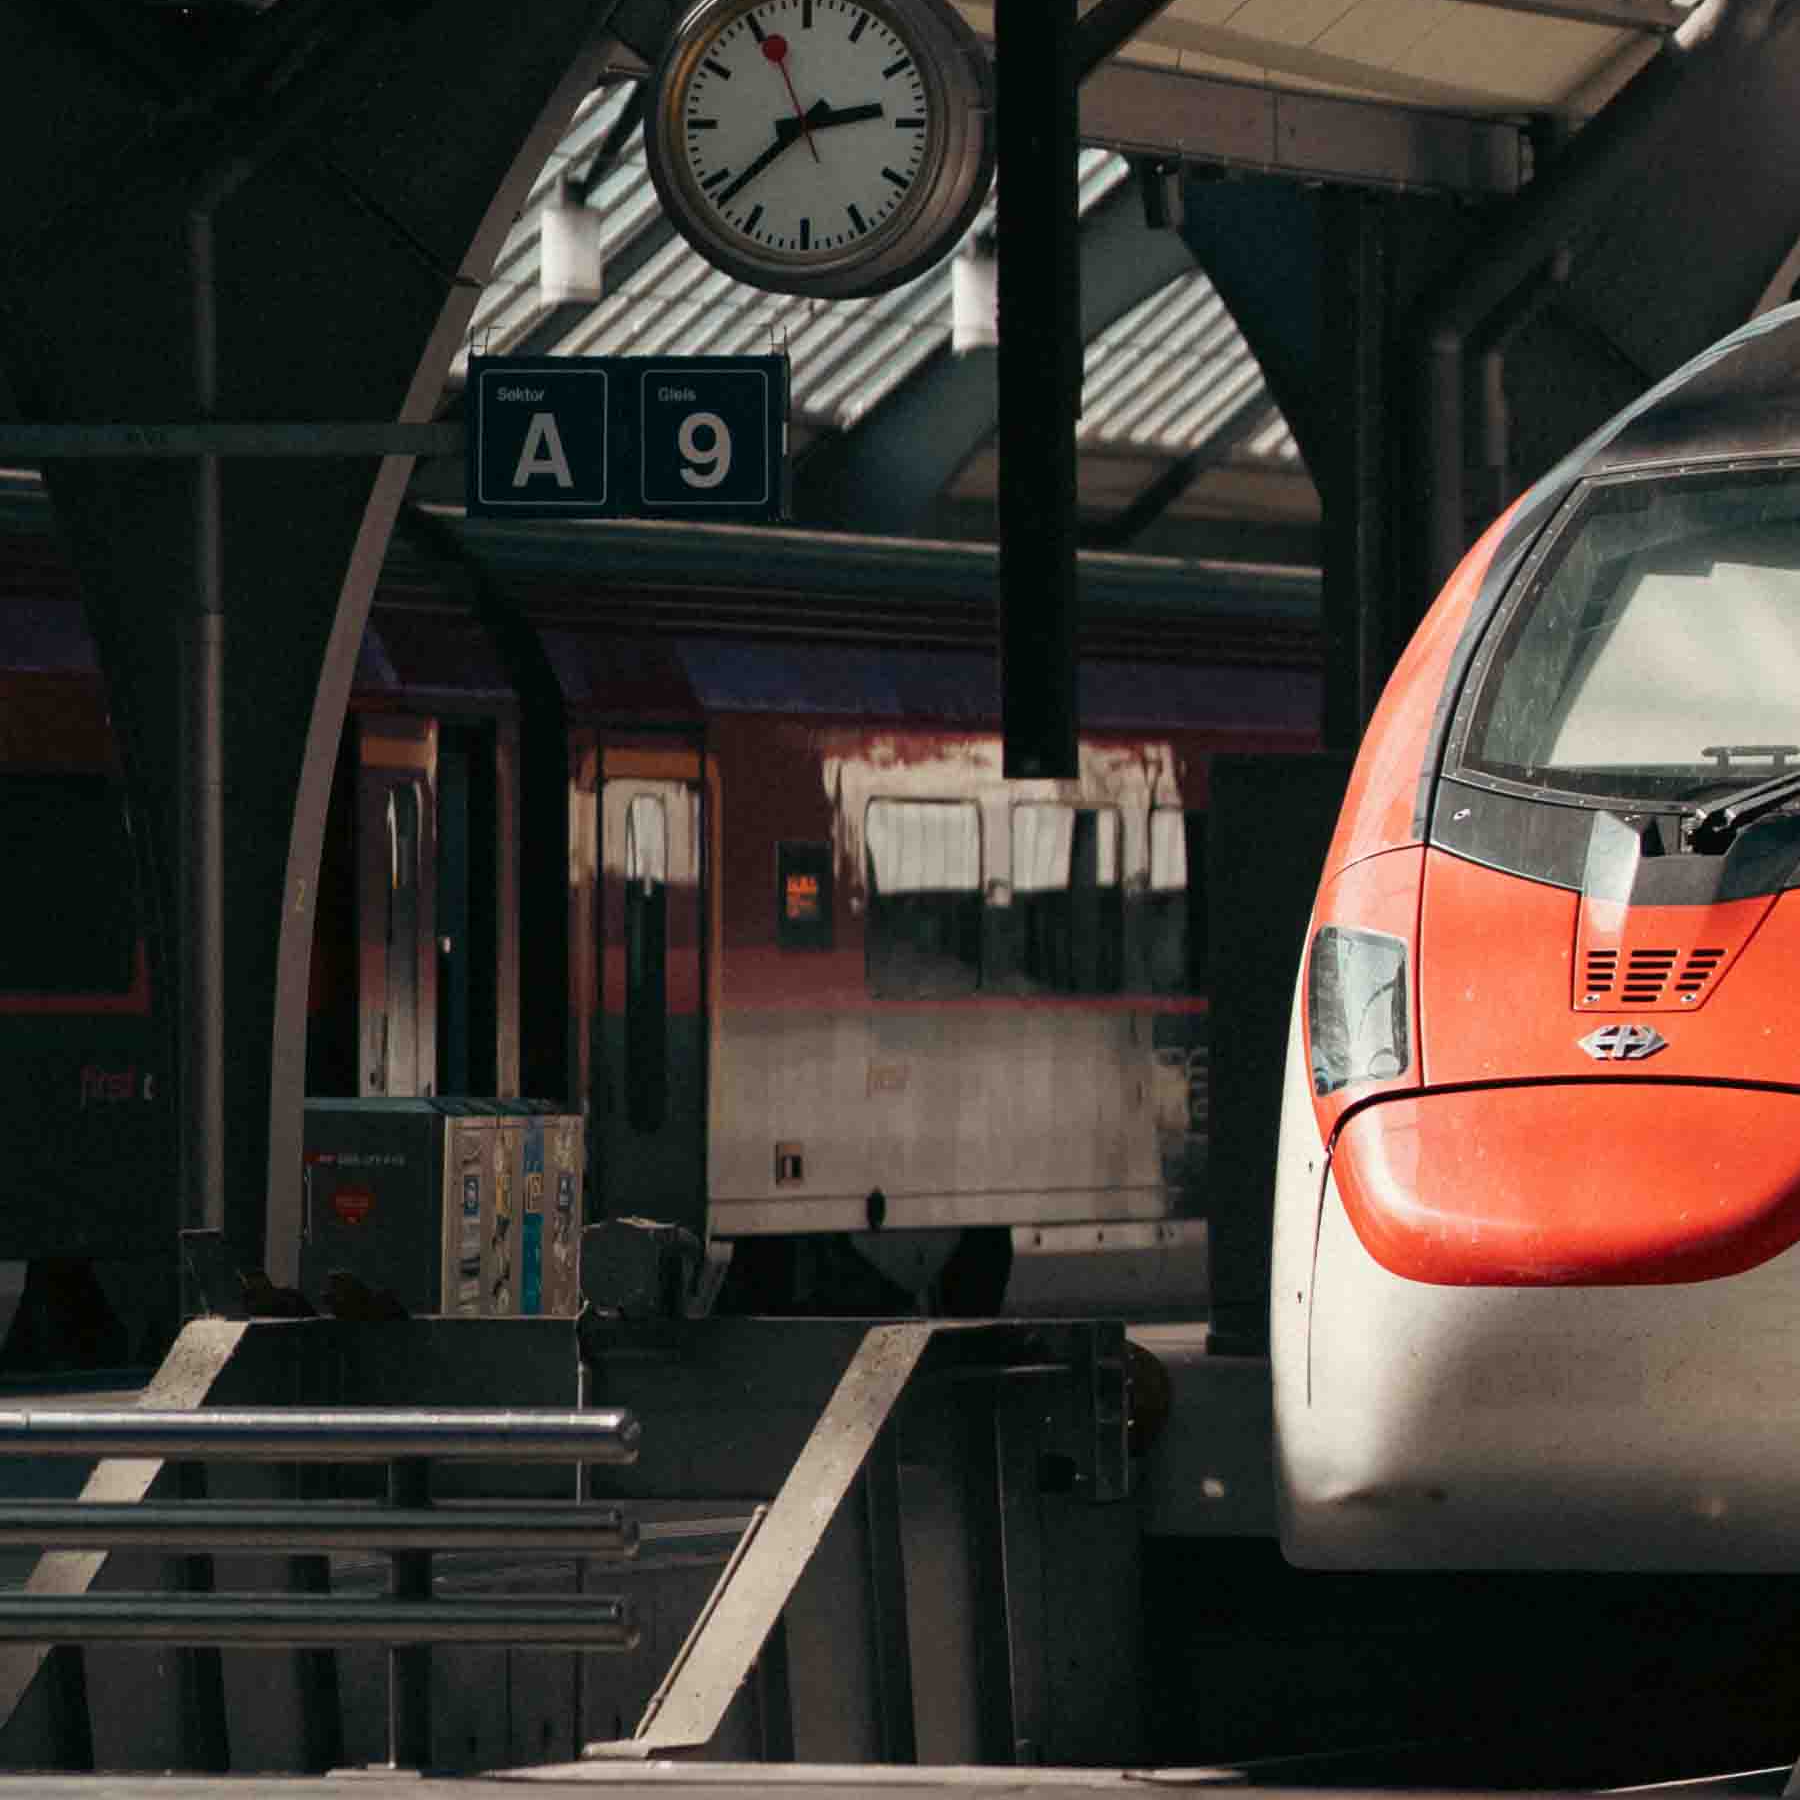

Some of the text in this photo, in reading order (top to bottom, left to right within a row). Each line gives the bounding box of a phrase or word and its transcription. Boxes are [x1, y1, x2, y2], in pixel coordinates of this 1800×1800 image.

[496, 385, 546, 402] Sektor
[657, 385, 697, 402] Gleis
[512, 411, 575, 489] A
[677, 410, 731, 489] 9
